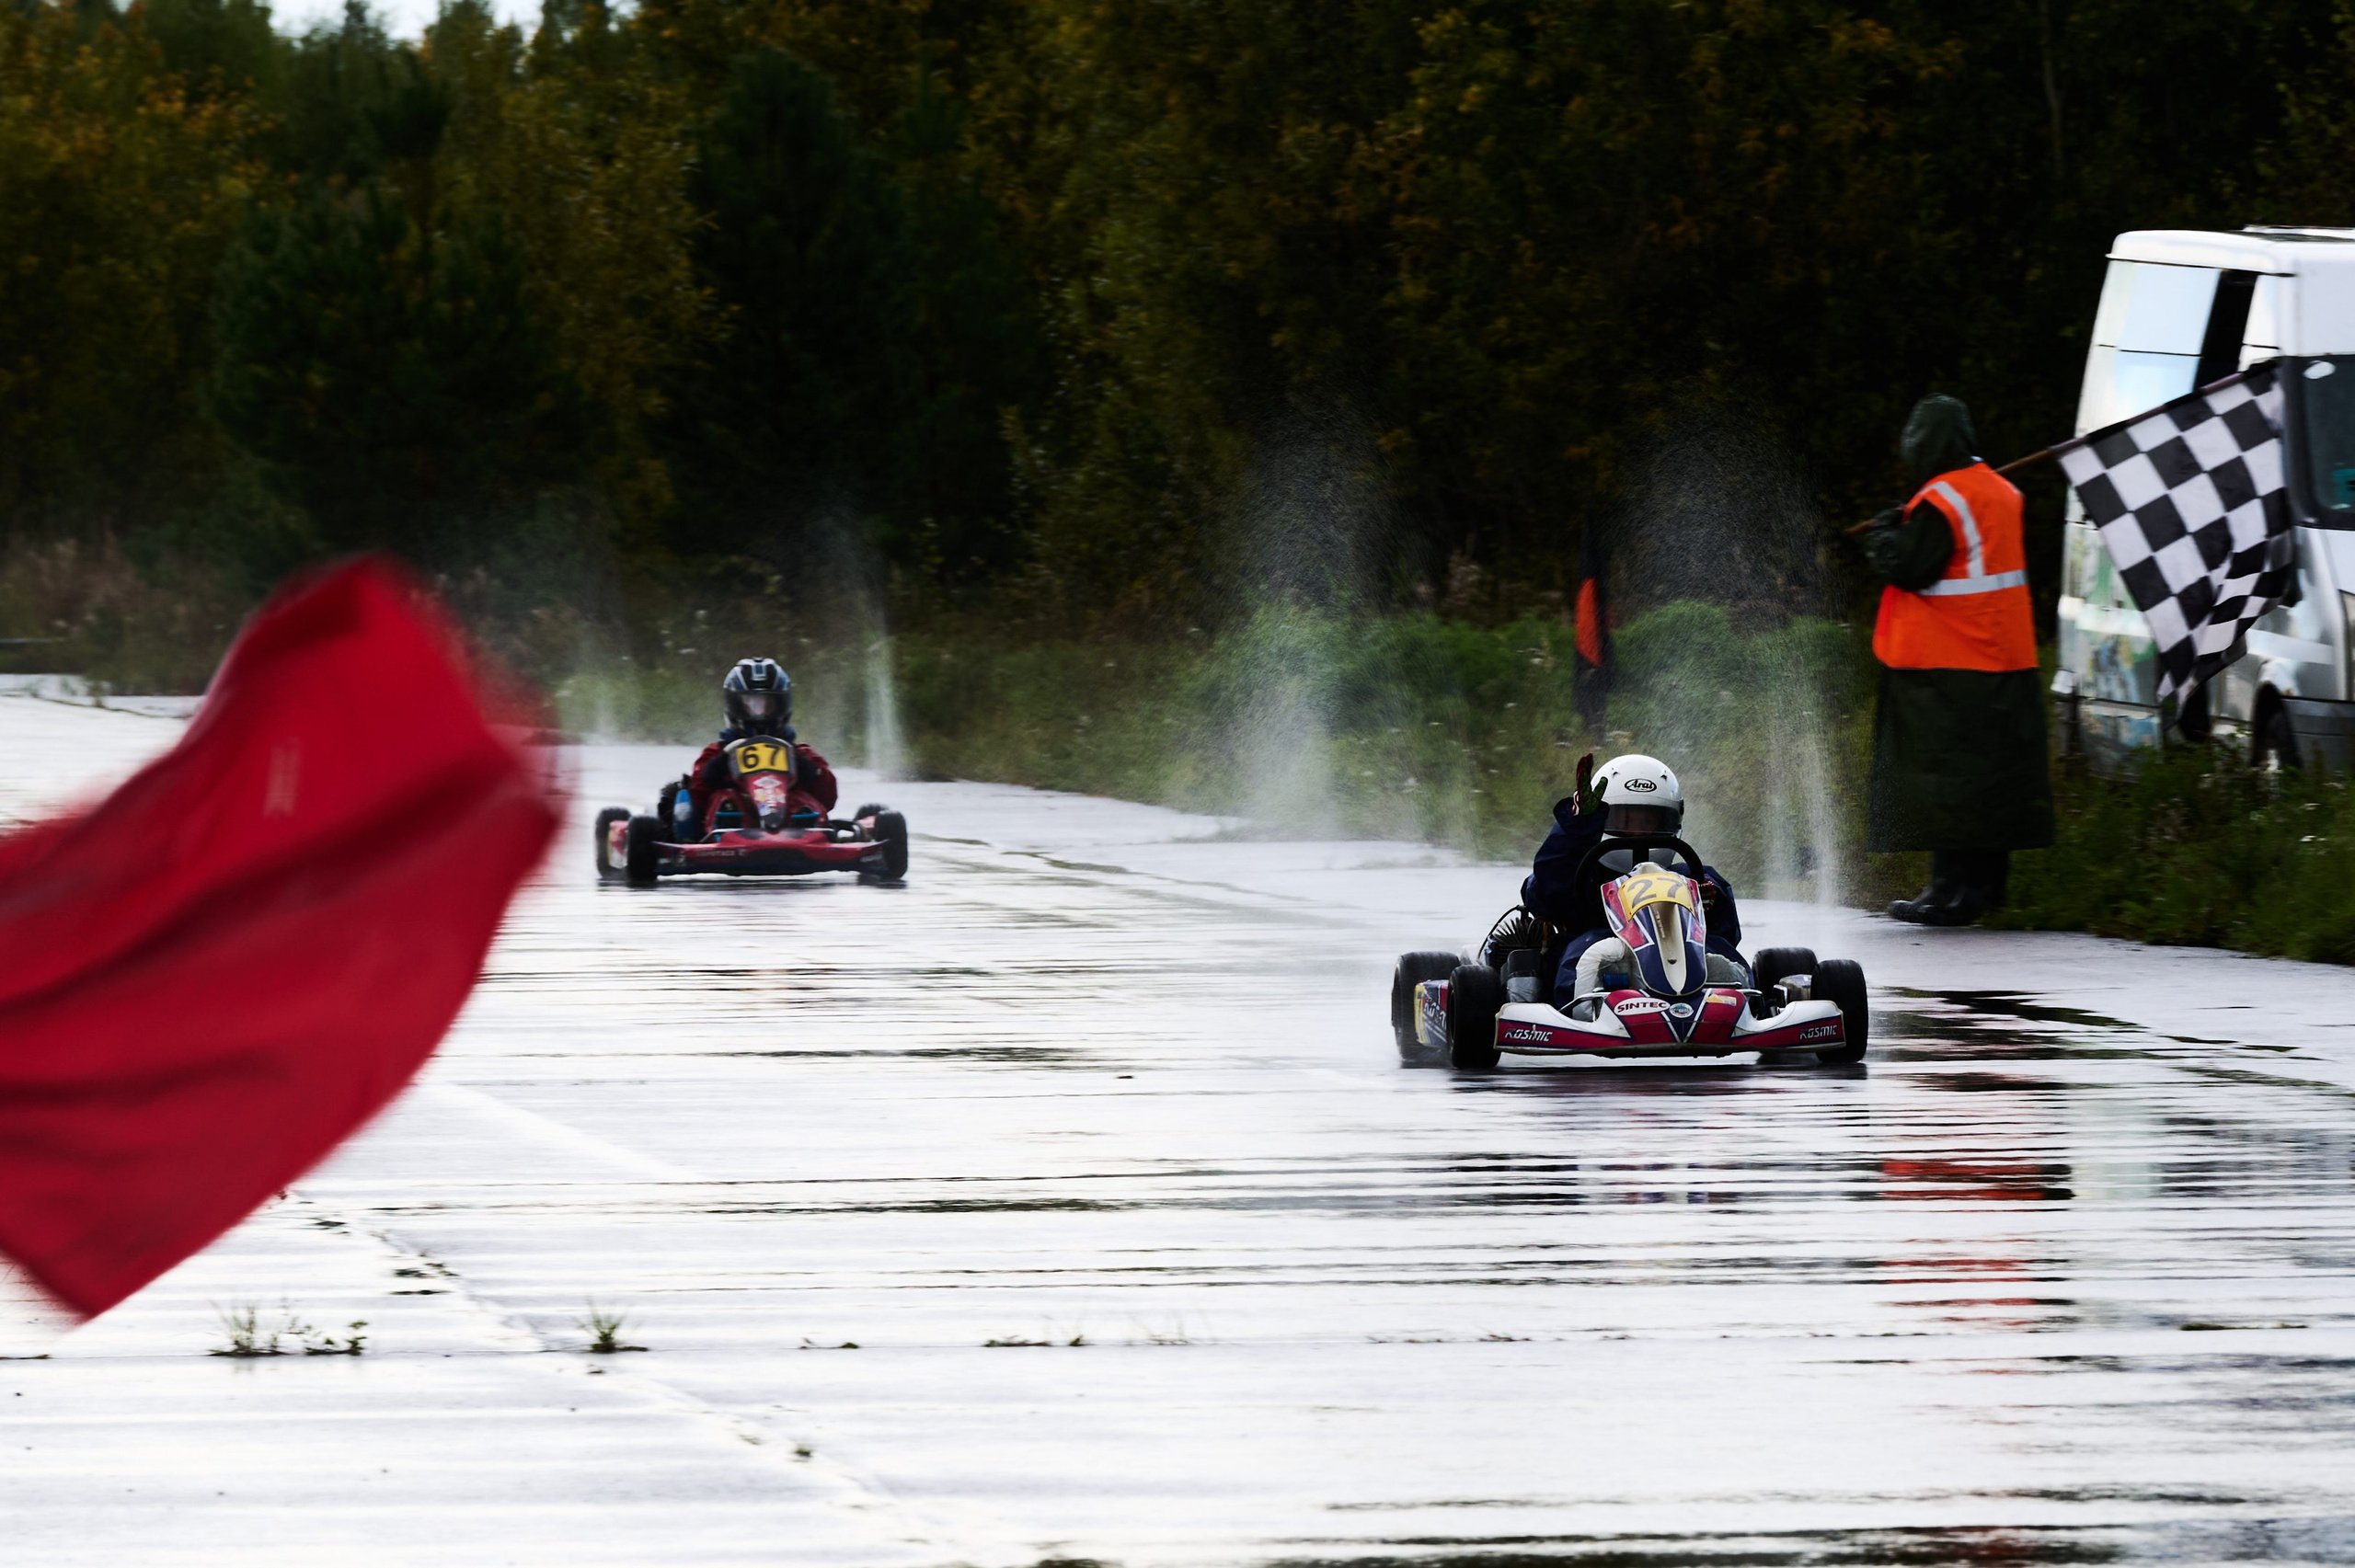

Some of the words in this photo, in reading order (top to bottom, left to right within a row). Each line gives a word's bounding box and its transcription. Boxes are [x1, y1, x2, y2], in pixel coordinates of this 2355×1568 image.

[742, 744, 780, 768] 67
[1626, 779, 1653, 789] Arai
[1627, 877, 1683, 908] 27
[1616, 1001, 1667, 1013] SINTEC
[1504, 1027, 1553, 1042] KOSMIC
[1799, 1024, 1838, 1040] KOSMIC
